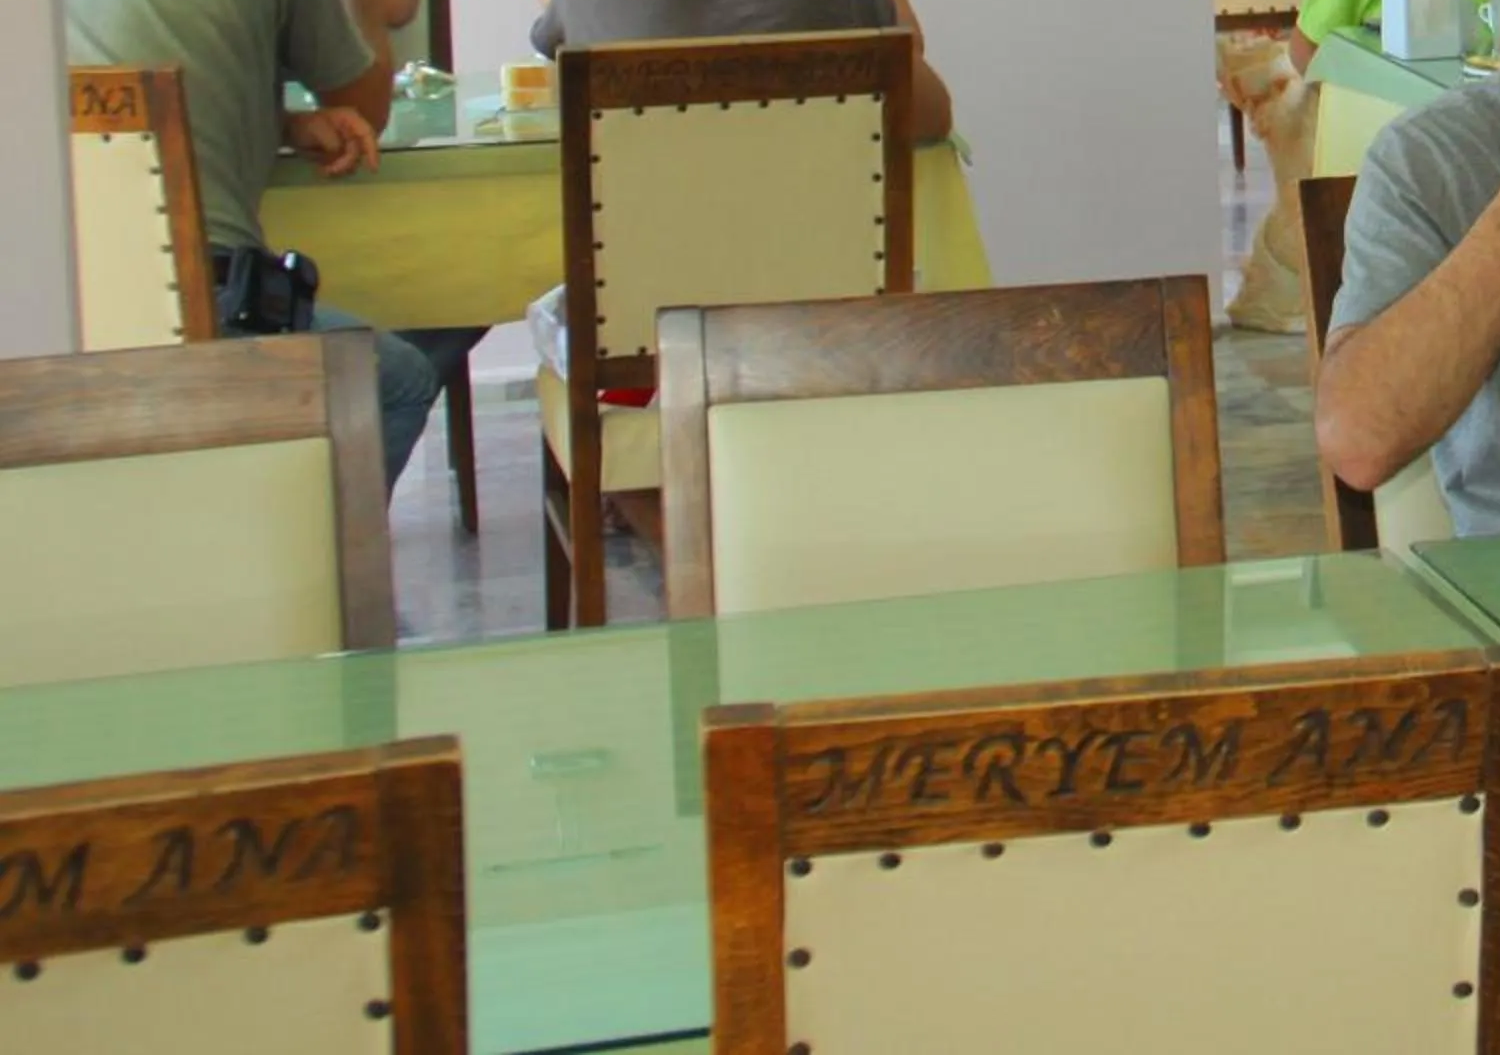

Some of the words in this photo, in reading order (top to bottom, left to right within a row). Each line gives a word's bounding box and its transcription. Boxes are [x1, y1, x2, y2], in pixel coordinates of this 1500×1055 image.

[805, 717, 1244, 813] MERYEM
[1265, 698, 1468, 787] ANA
[120, 804, 358, 907] ANA
